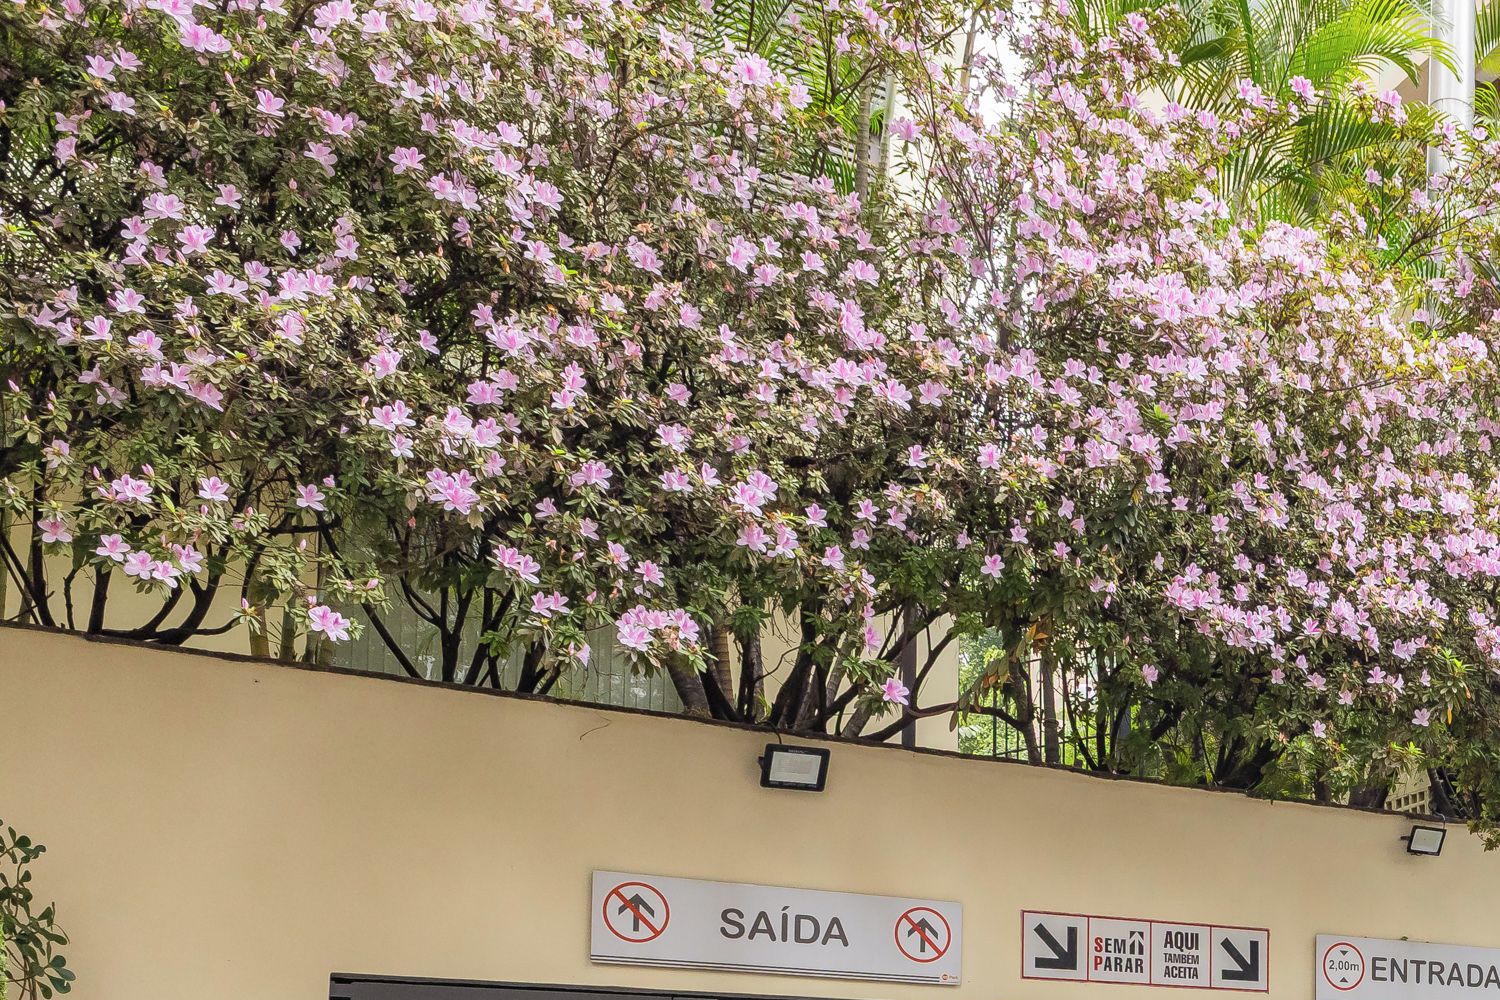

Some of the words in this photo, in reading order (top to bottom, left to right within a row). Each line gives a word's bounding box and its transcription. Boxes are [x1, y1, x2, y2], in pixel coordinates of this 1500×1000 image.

[719, 906, 849, 948] SAÍDA
[1094, 936, 1127, 955] SEM
[1163, 930, 1200, 951] AQUI
[1093, 955, 1144, 974] PARAR
[1163, 952, 1200, 965] TAMBÉM
[1328, 959, 1360, 972] 2,00m
[1163, 965, 1199, 980] ACEITA
